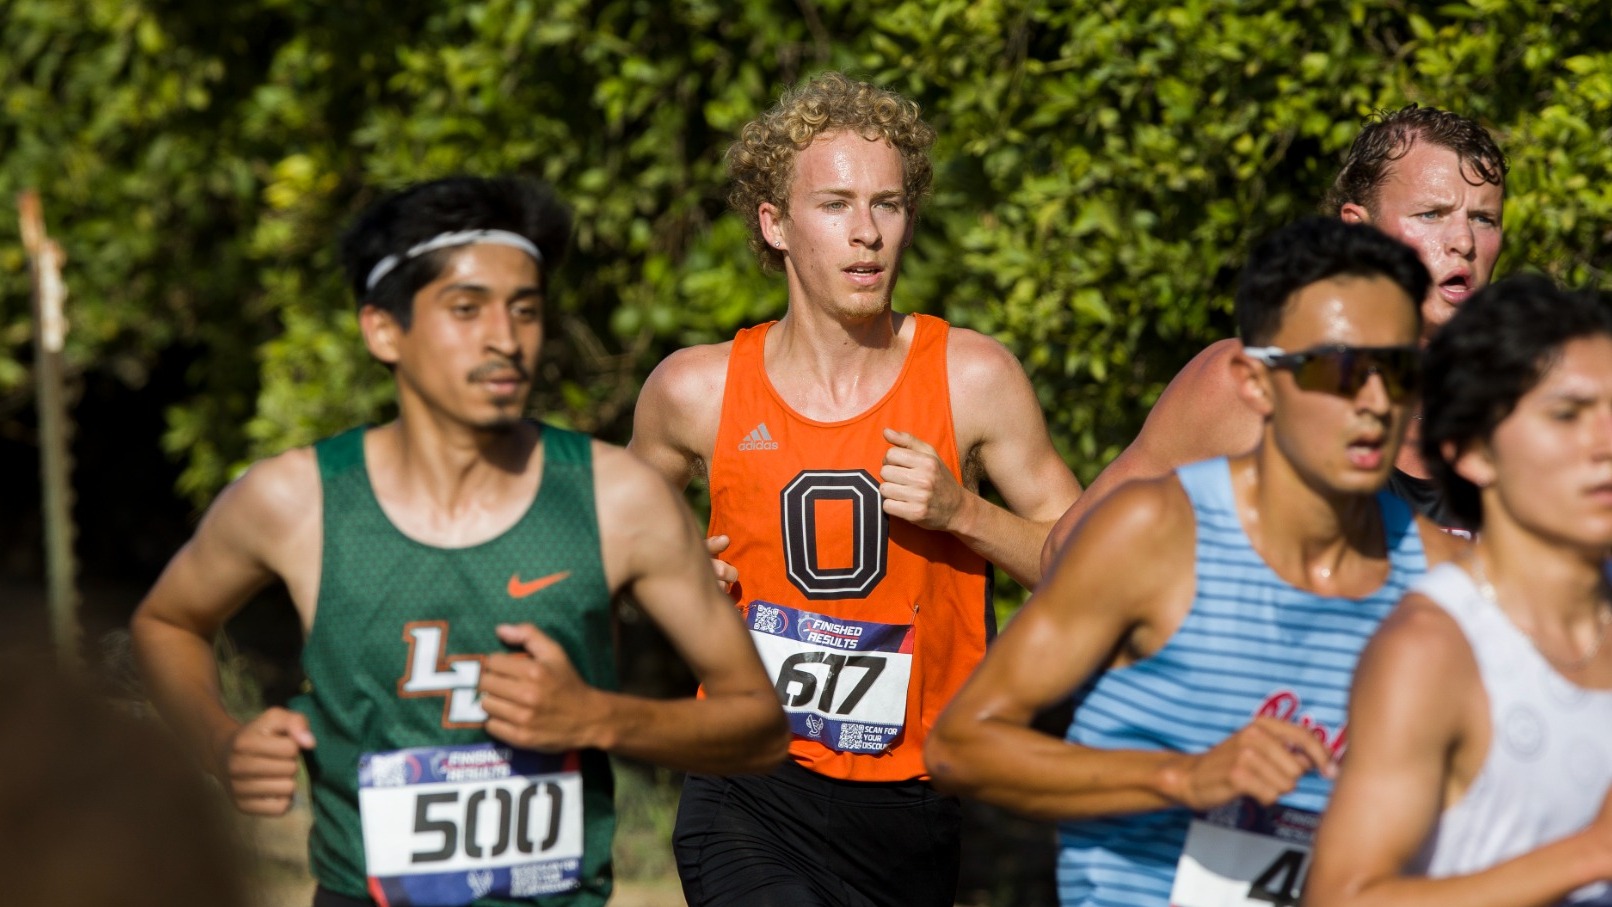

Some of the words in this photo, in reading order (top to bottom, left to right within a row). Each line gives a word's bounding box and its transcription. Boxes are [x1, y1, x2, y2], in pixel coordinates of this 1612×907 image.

[738, 440, 779, 451] adidas
[812, 619, 863, 637] FINISHED
[807, 632, 859, 650] RESULTS
[775, 651, 888, 715] 617
[863, 733, 882, 742] YOUR
[864, 725, 884, 735] SCAN
[884, 727, 898, 736] FOR
[862, 741, 889, 751] DISCOU
[411, 782, 564, 864] 500
[1246, 847, 1307, 907] 4
